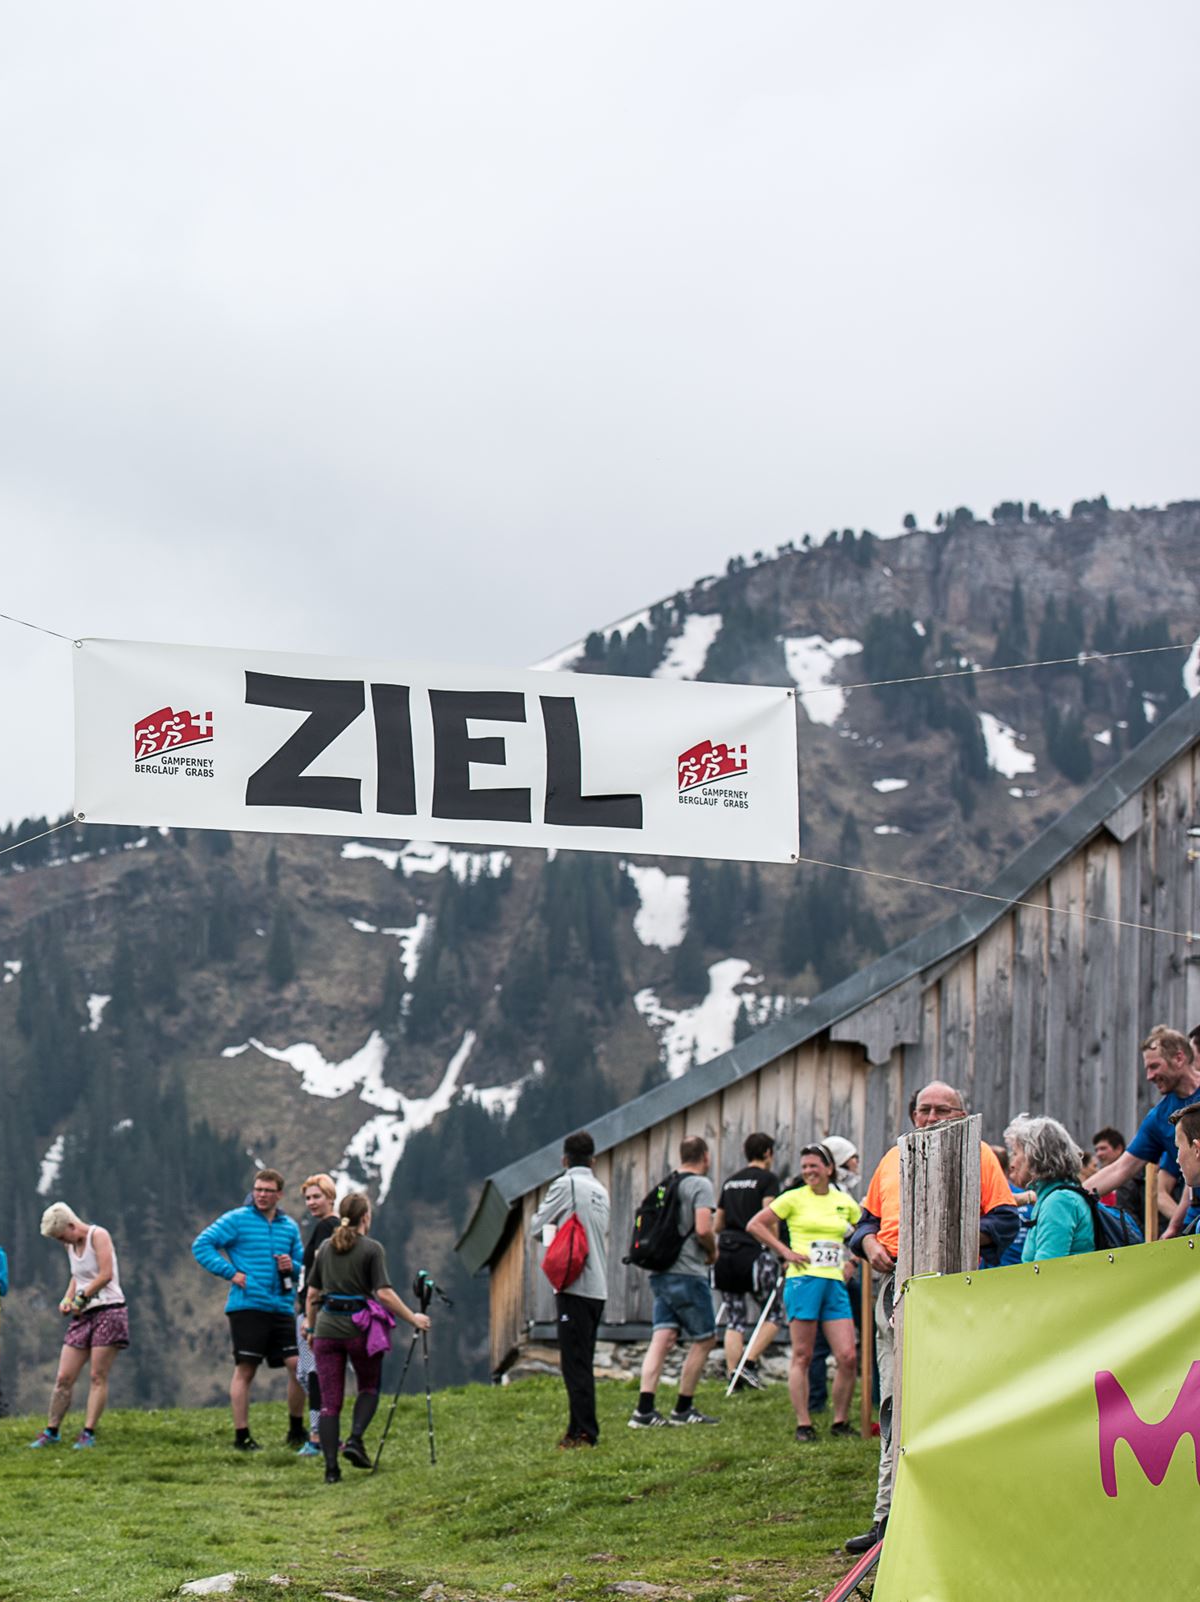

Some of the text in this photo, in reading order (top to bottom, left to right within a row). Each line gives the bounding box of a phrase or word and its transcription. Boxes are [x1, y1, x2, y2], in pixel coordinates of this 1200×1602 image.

[244, 671, 643, 829] ZIEL
[161, 756, 214, 768] GAMPERNEY
[135, 764, 214, 778] BERGLAUF GRABS
[702, 788, 748, 799] GAMPERNEY
[679, 796, 749, 809] BERGLAUF GRABS
